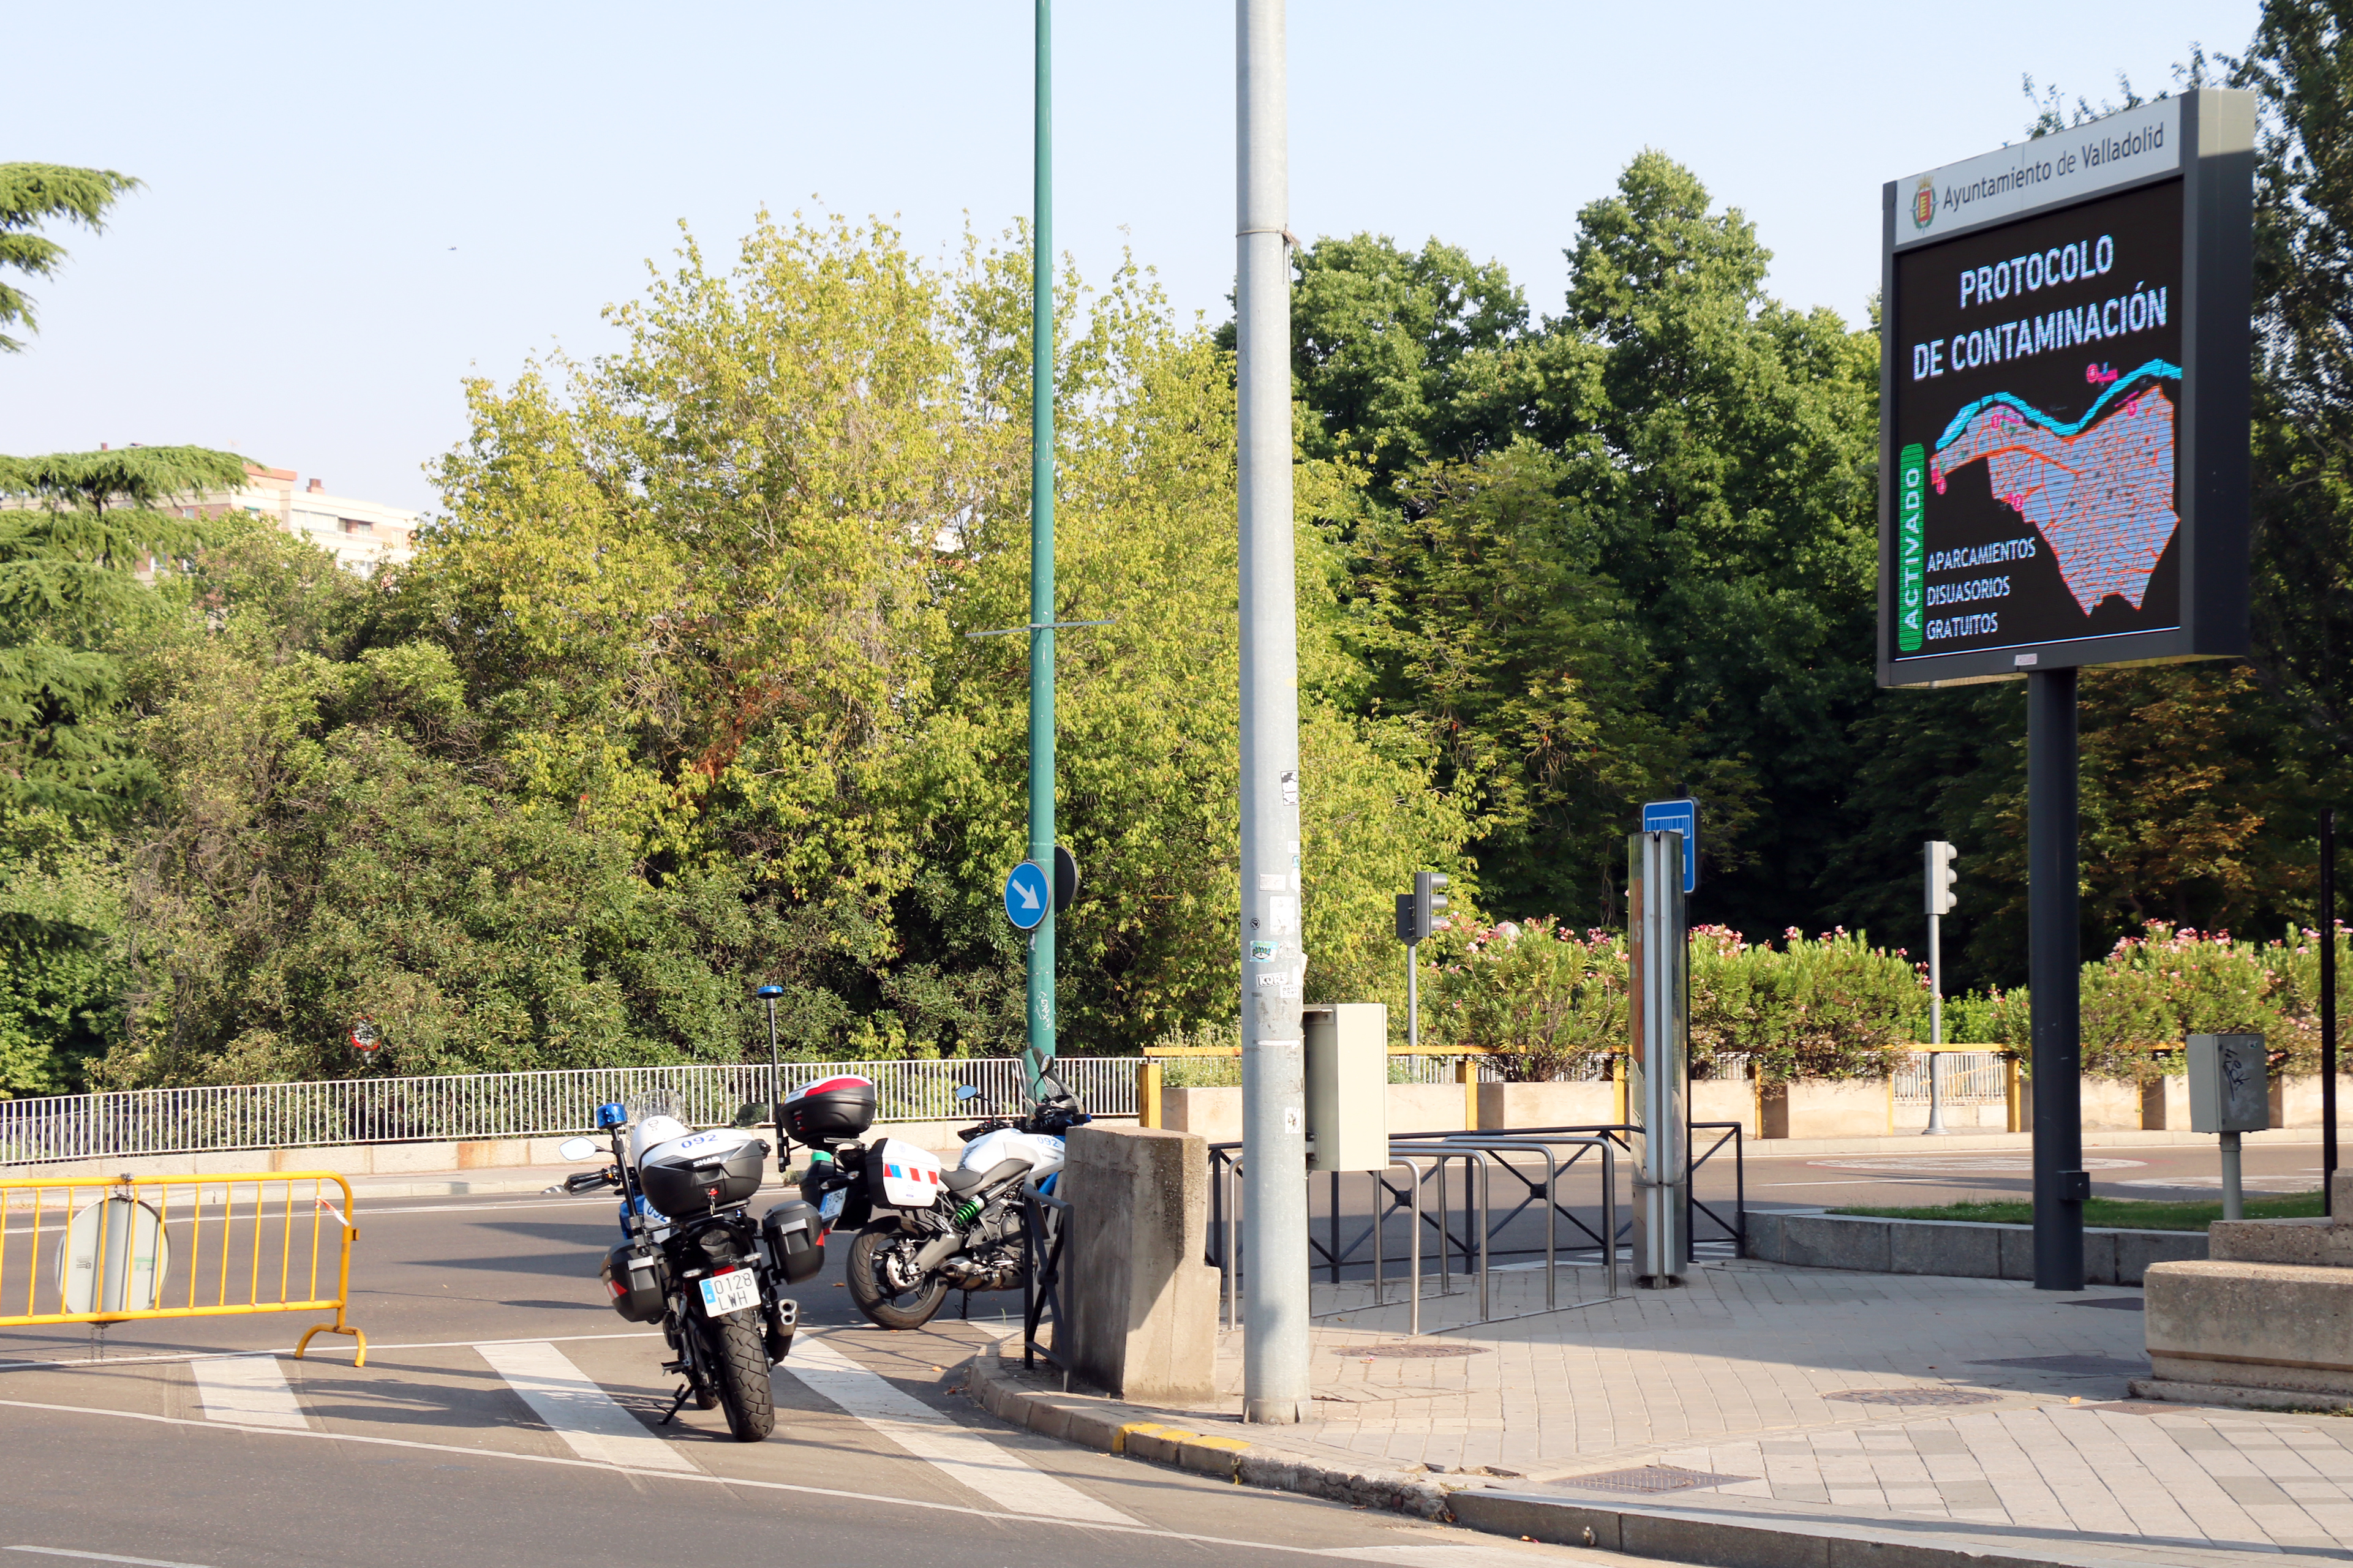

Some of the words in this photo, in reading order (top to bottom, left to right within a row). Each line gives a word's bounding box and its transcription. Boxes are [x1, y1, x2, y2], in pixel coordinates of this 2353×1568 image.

[1943, 160, 2052, 212] Ayuntamiento
[2057, 150, 2076, 176] de
[2082, 121, 2164, 169] Valladolid
[1960, 234, 2114, 309] PROTOCOLO
[1913, 338, 1945, 381] DE
[1951, 280, 2167, 372] CONTAMINACIÓN
[1904, 467, 1921, 631] ACTIVADO
[1926, 536, 2036, 572] APARCAMIENTOS
[1926, 576, 2011, 607] DISUASORIOS
[1926, 612, 1998, 640] GRATUITOS
[681, 1134, 718, 1149] 092
[1037, 1136, 1059, 1148] 092
[693, 1155, 721, 1168] SHAD
[714, 1272, 752, 1294] 0128
[718, 1290, 748, 1311] LWH
